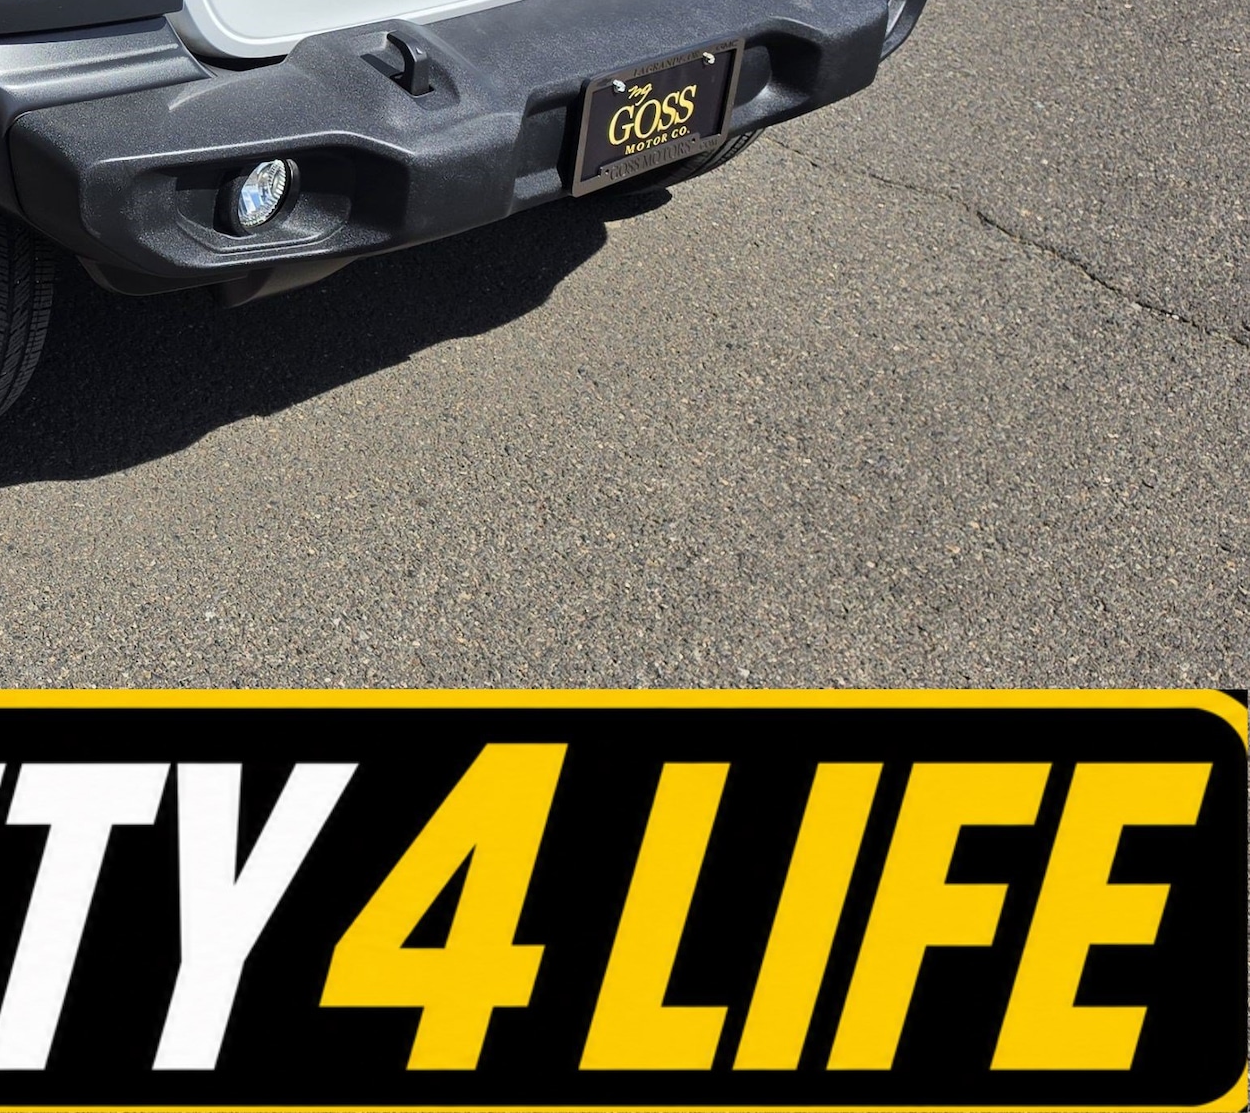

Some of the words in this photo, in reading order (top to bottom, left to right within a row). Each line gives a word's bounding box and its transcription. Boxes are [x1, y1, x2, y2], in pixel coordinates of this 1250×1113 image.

[608, 84, 698, 146] GOSS
[624, 133, 668, 155] MOTOR
[671, 125, 691, 138] CO.
